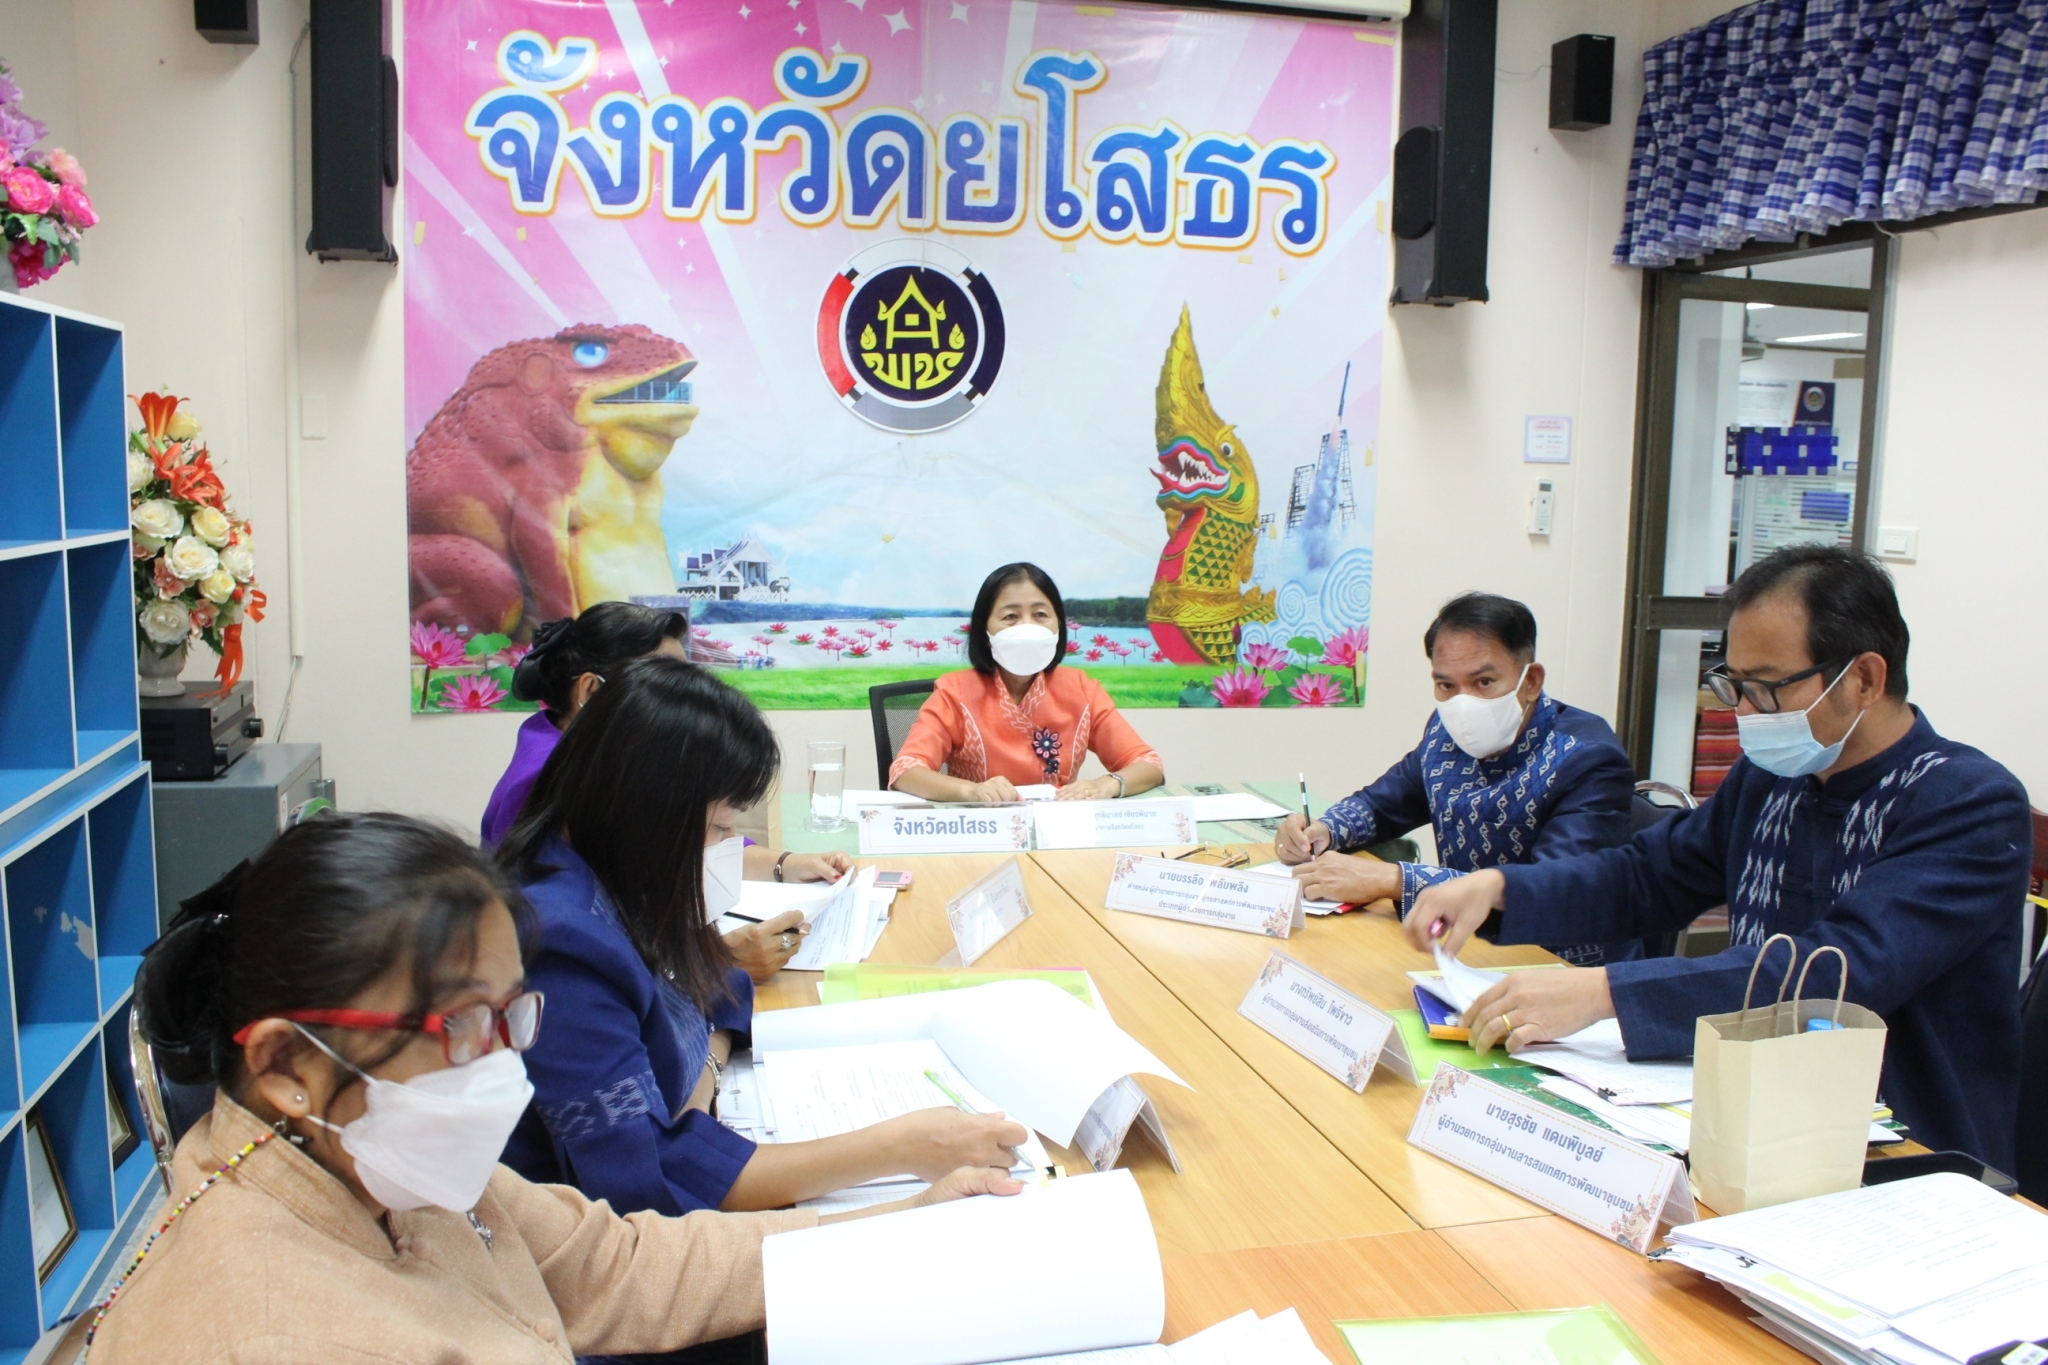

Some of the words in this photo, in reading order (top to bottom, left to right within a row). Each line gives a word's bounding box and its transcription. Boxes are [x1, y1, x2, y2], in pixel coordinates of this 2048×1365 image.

[470, 30, 1331, 250] จังหวัดยโสธร
[893, 815, 998, 836] จังหวัดยโสธร
[1438, 1114, 1634, 1213] ผู้อำนวยการกลุ่มงานสารสนเทศการพัฒนาชุมชน
[1486, 1103, 1538, 1135] นายสุรชัย
[1542, 1128, 1604, 1163] แดนพิบูลย์
